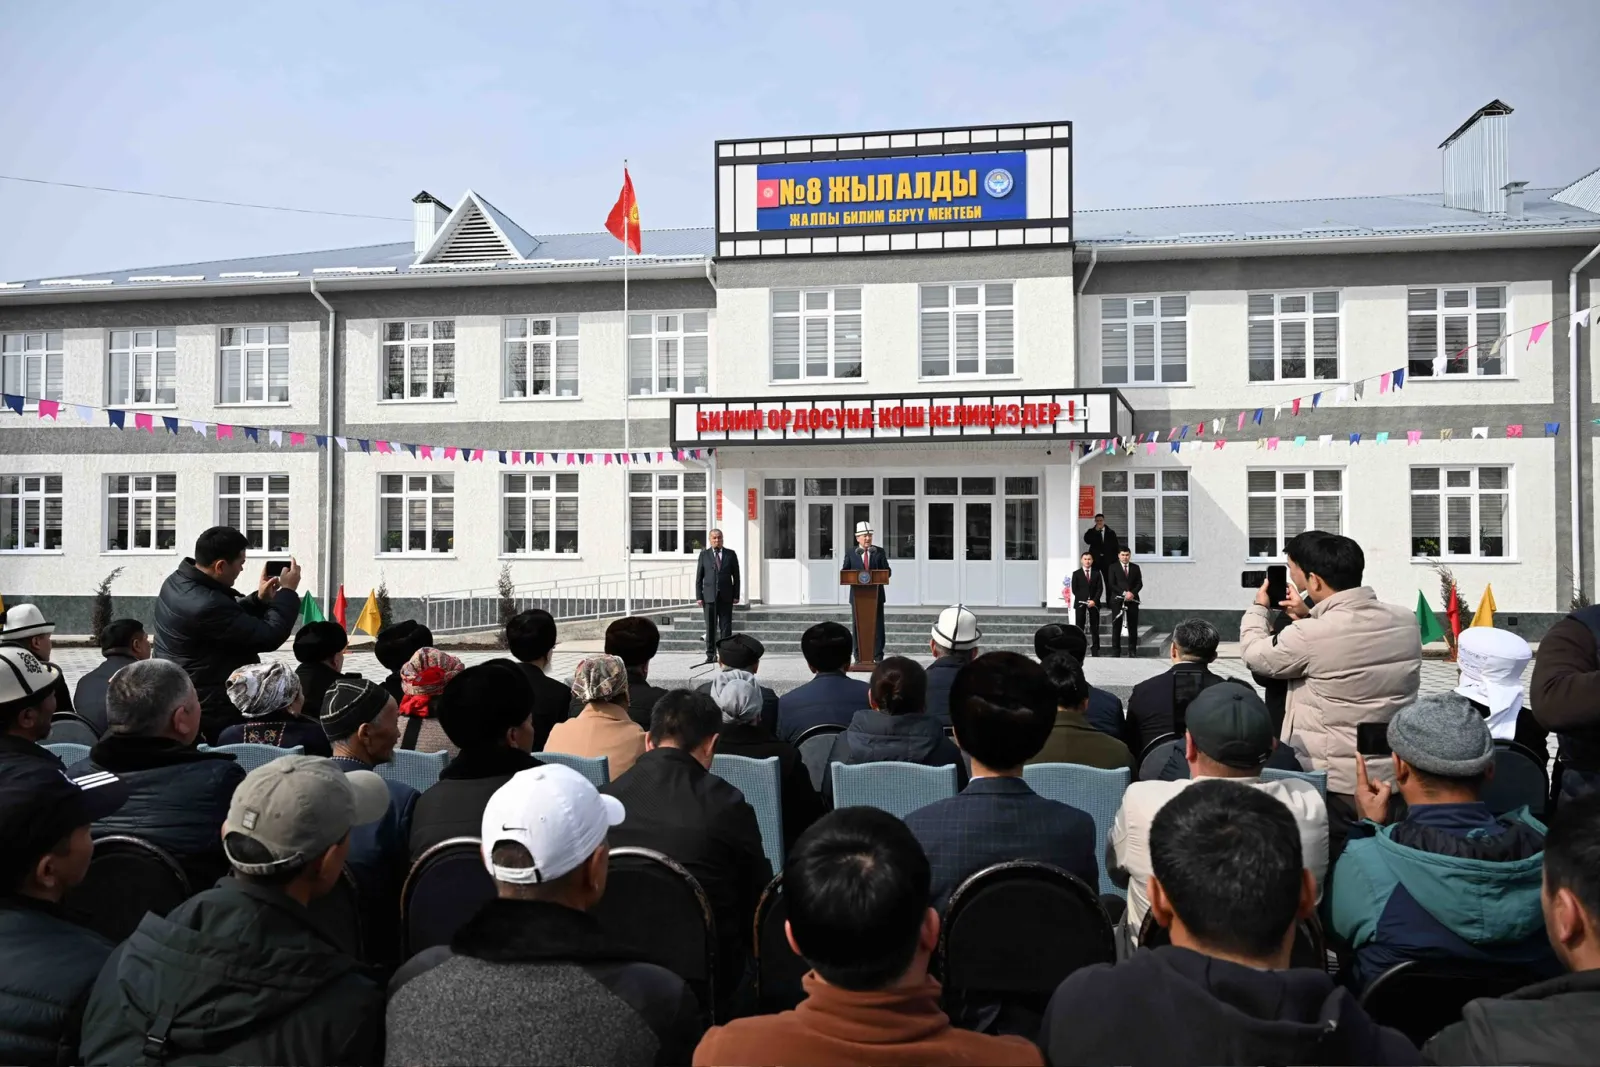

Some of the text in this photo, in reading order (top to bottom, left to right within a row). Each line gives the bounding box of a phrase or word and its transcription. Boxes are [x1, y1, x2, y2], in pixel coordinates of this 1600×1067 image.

[780, 169, 977, 206] №8 ЖЫЛАЛДЫ
[789, 206, 982, 227] ЖАЛПЫ БИЛИМ БЕРҮҮ МЕКТЕБИ
[696, 409, 763, 432] БИЛИМ
[767, 408, 874, 432] ОРДОСУНА
[878, 405, 925, 428] КОШ
